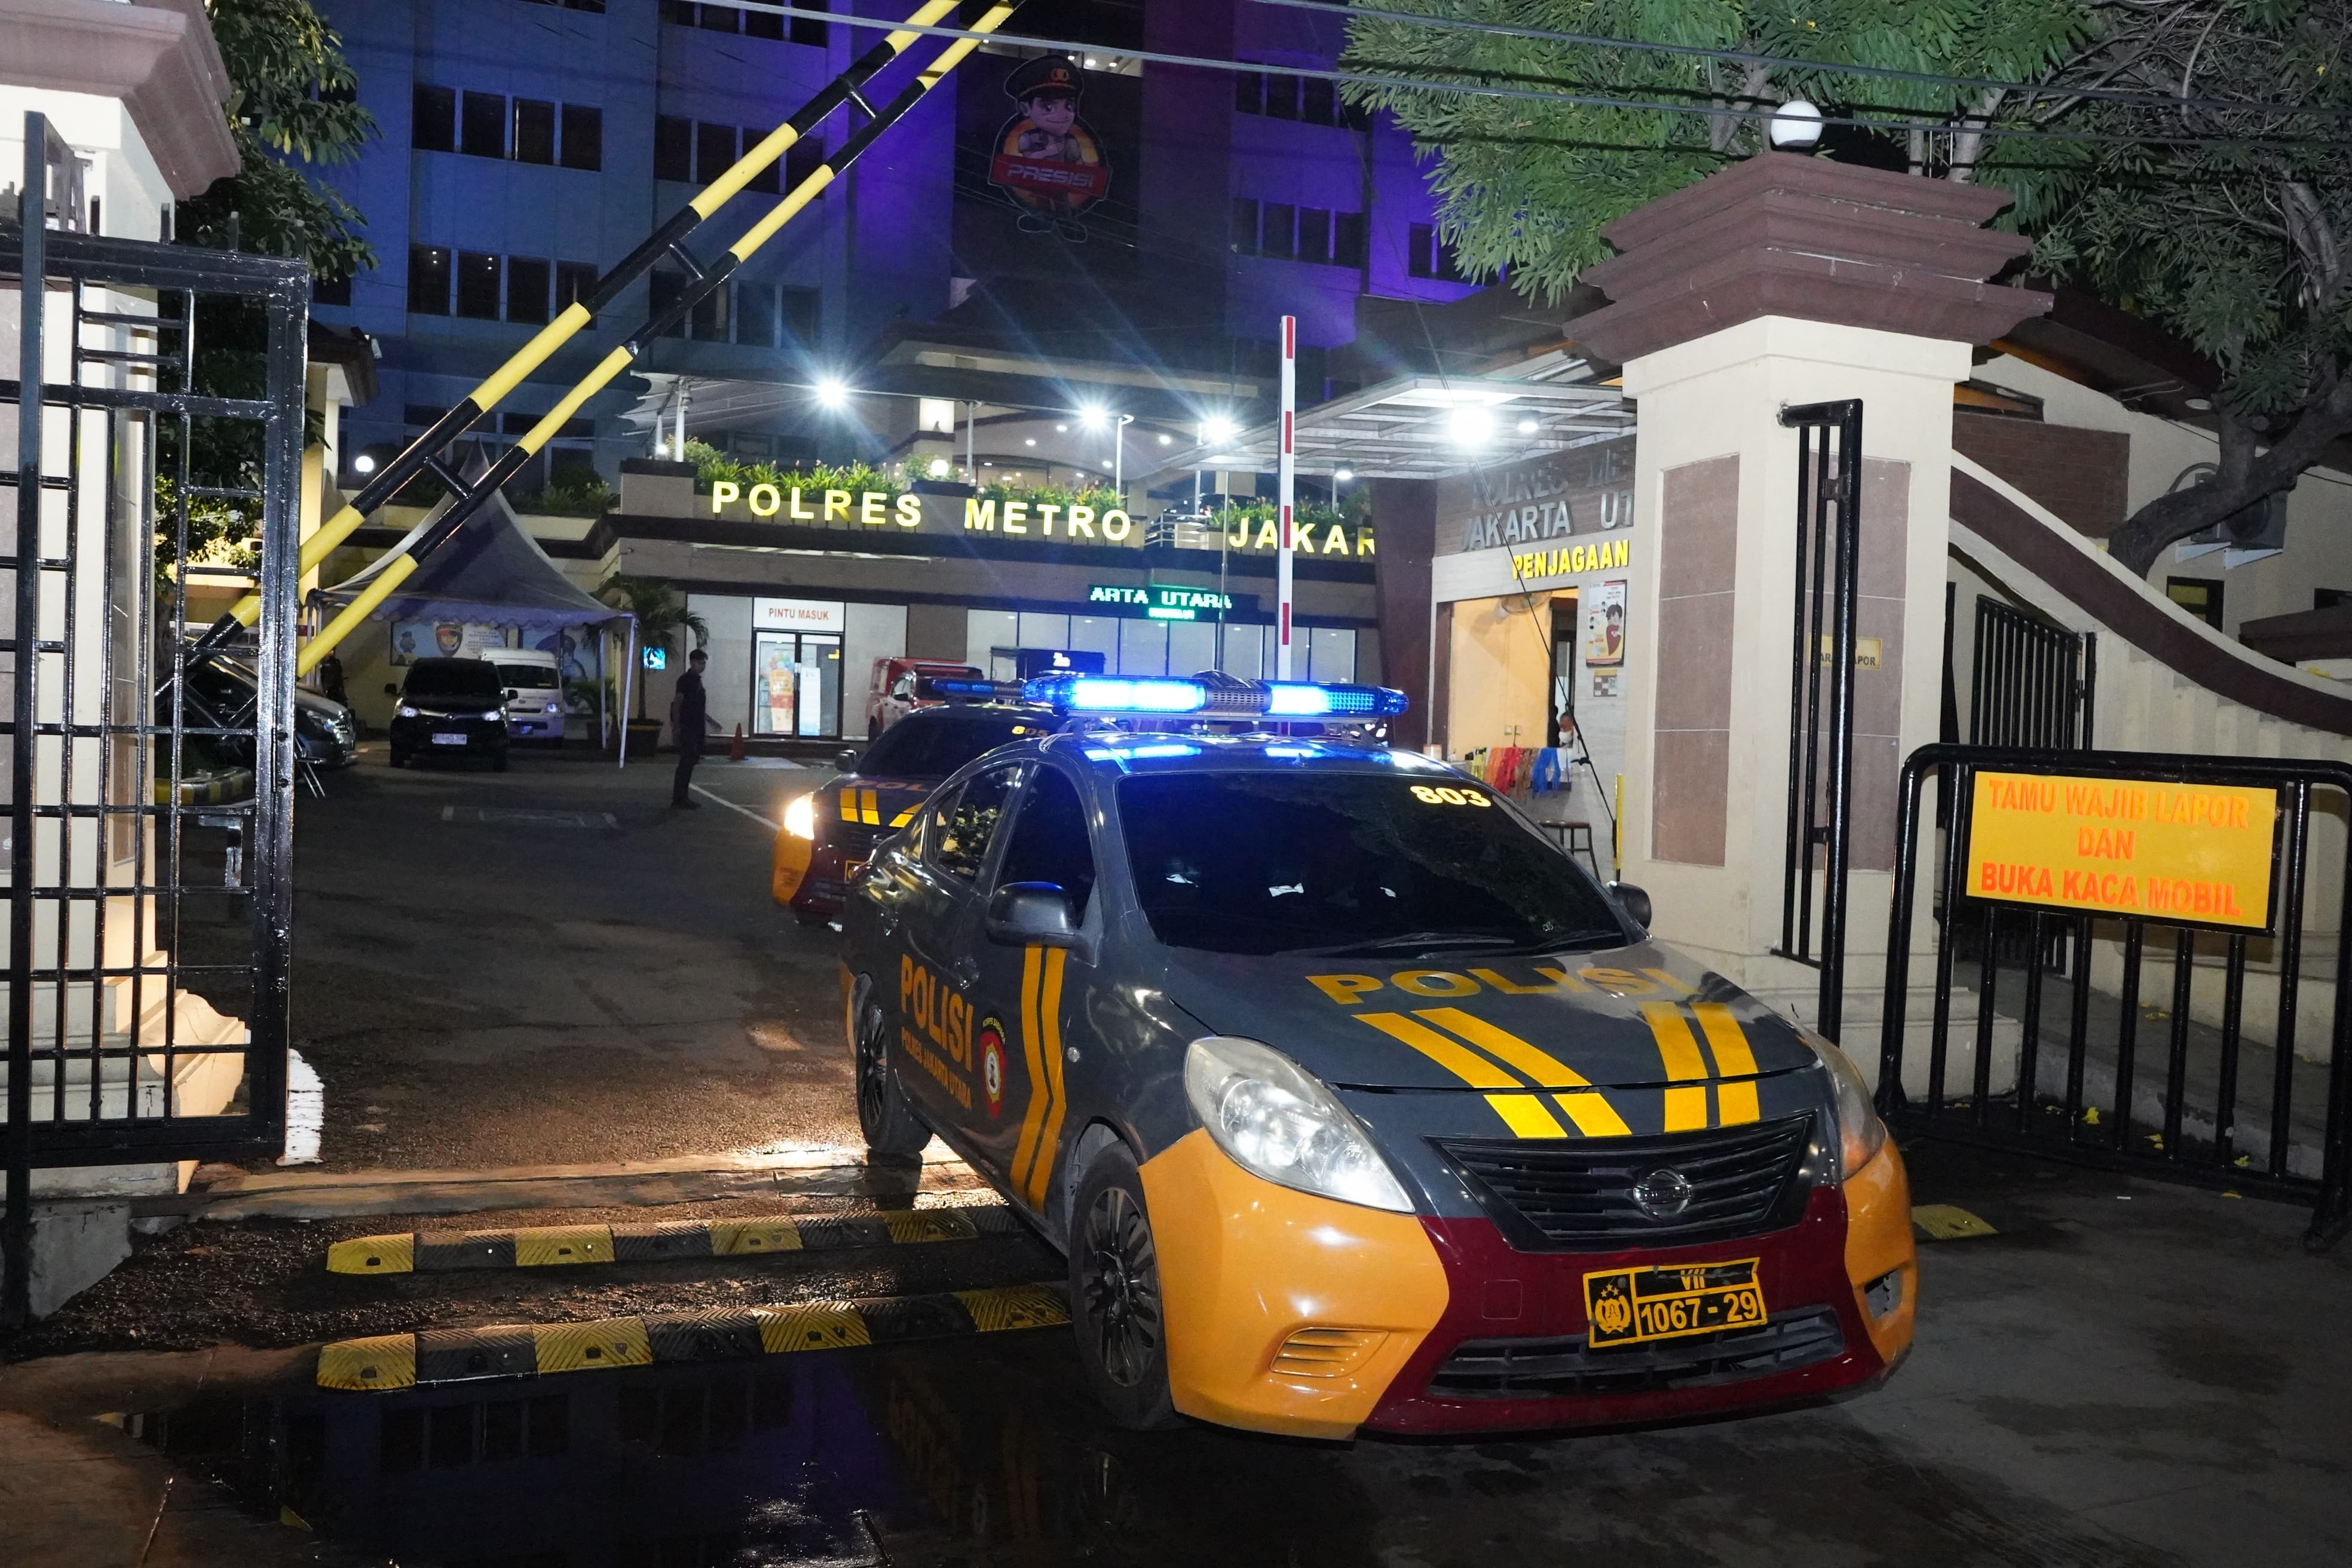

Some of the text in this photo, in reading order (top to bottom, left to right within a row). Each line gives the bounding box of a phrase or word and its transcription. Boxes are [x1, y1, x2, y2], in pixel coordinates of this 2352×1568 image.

[1008, 164, 1095, 188] PRESISI
[712, 481, 921, 528] POLRES
[964, 498, 1131, 541] METRO
[1462, 500, 1571, 551] JAKARTA
[1512, 539, 1630, 580] PENJAGAAN
[768, 608, 829, 620] PINTU MASUK
[1161, 590, 1232, 609] UTARA
[1410, 786, 1492, 807] 803
[1989, 779, 2250, 829] TAMU WAJIB LAPOR
[2078, 826, 2136, 860] DAN
[1980, 862, 2243, 918] BUKA KACA MOBIL
[1305, 967, 1701, 1004] POLISI
[901, 953, 973, 1073] POLISI
[1680, 1268, 1706, 1290] VII
